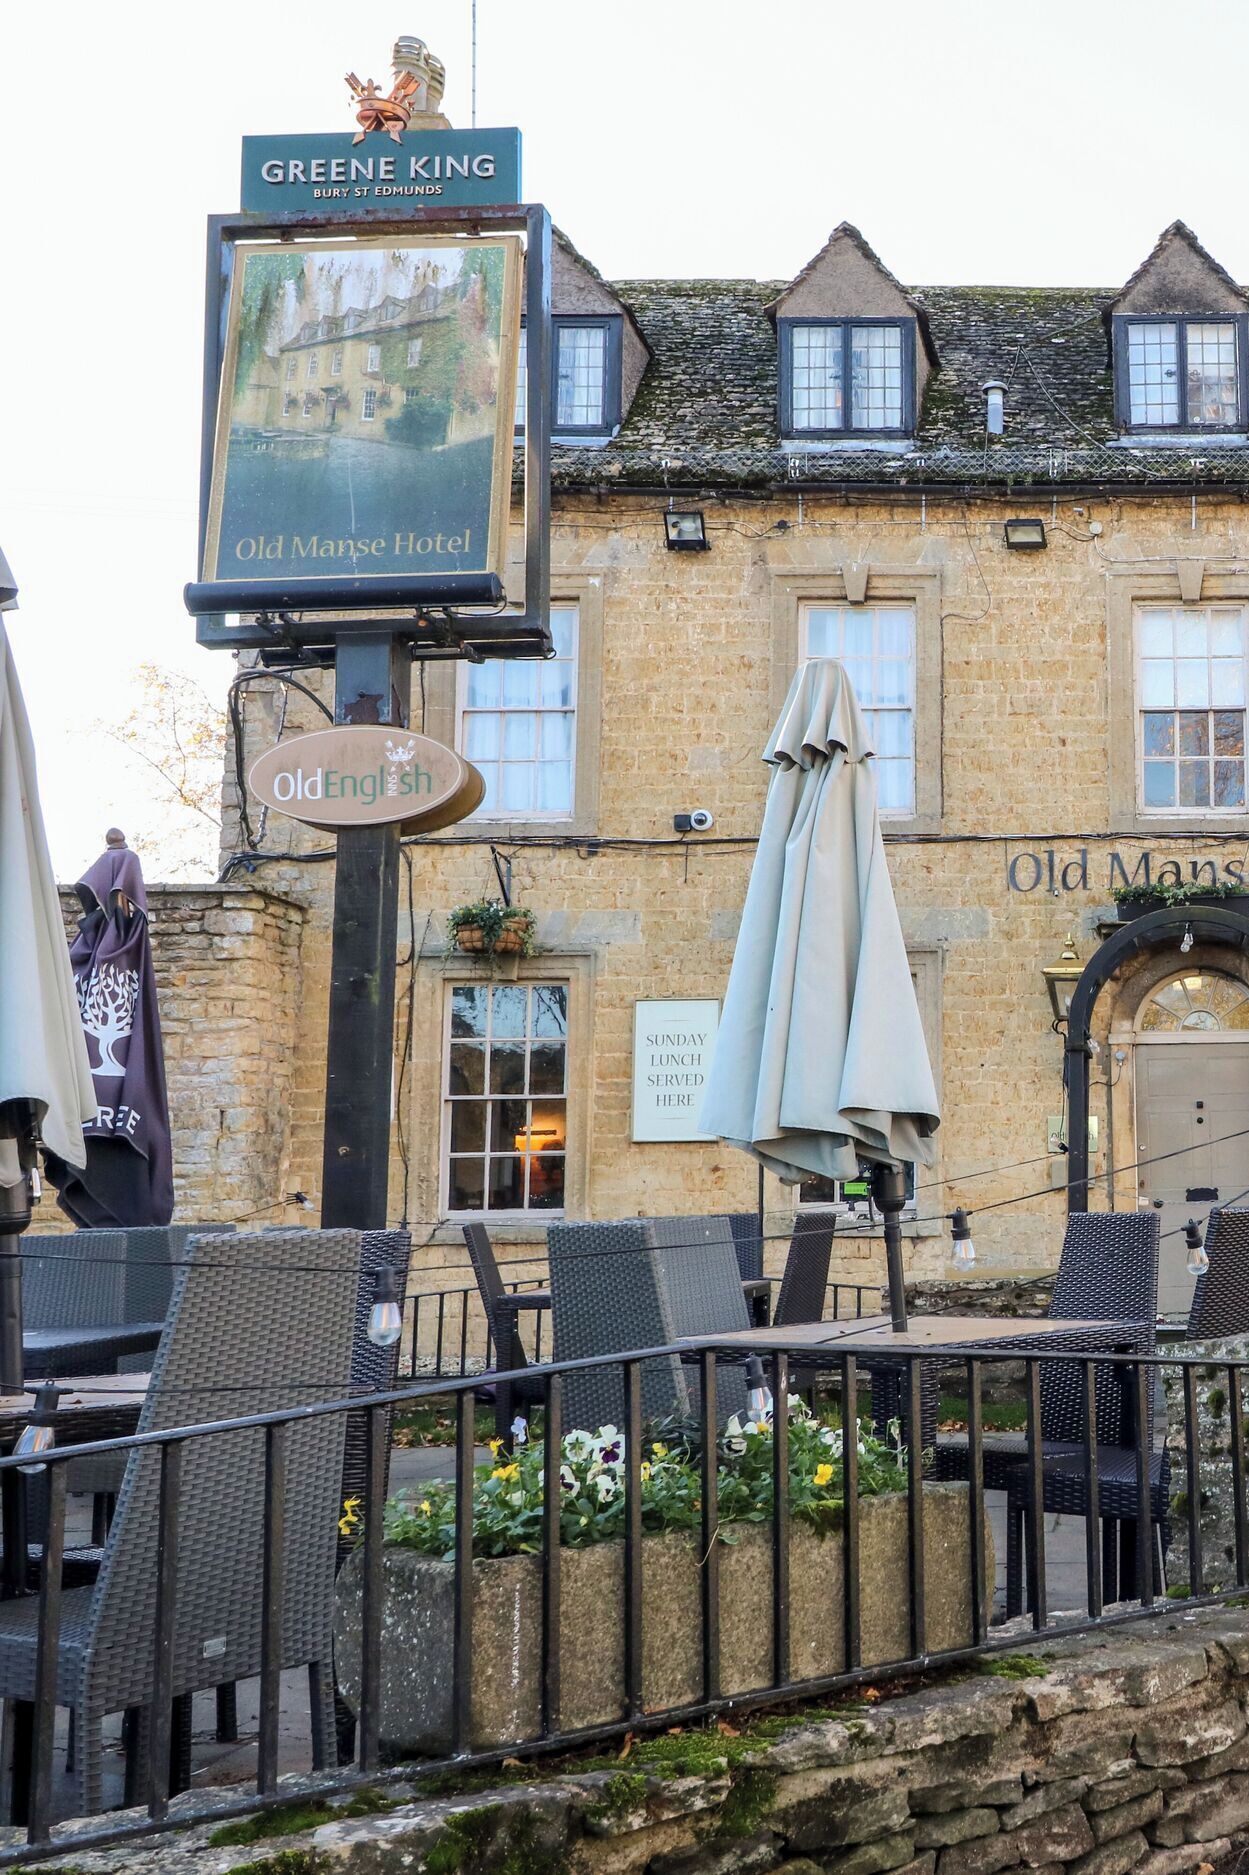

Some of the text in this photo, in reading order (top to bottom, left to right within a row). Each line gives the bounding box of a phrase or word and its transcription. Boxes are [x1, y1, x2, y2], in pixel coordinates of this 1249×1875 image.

[261, 154, 497, 184] GREENE KING
[313, 184, 443, 199] BURY ST EDMUNDS
[235, 529, 472, 561] Old Manse Hotel
[387, 773, 399, 797] INNS
[1007, 849, 1092, 893] Old
[646, 1033, 707, 1047] SUNDAY
[651, 1053, 701, 1066] LUNCH
[647, 1073, 704, 1086] SERVED
[656, 1094, 695, 1106] HERE
